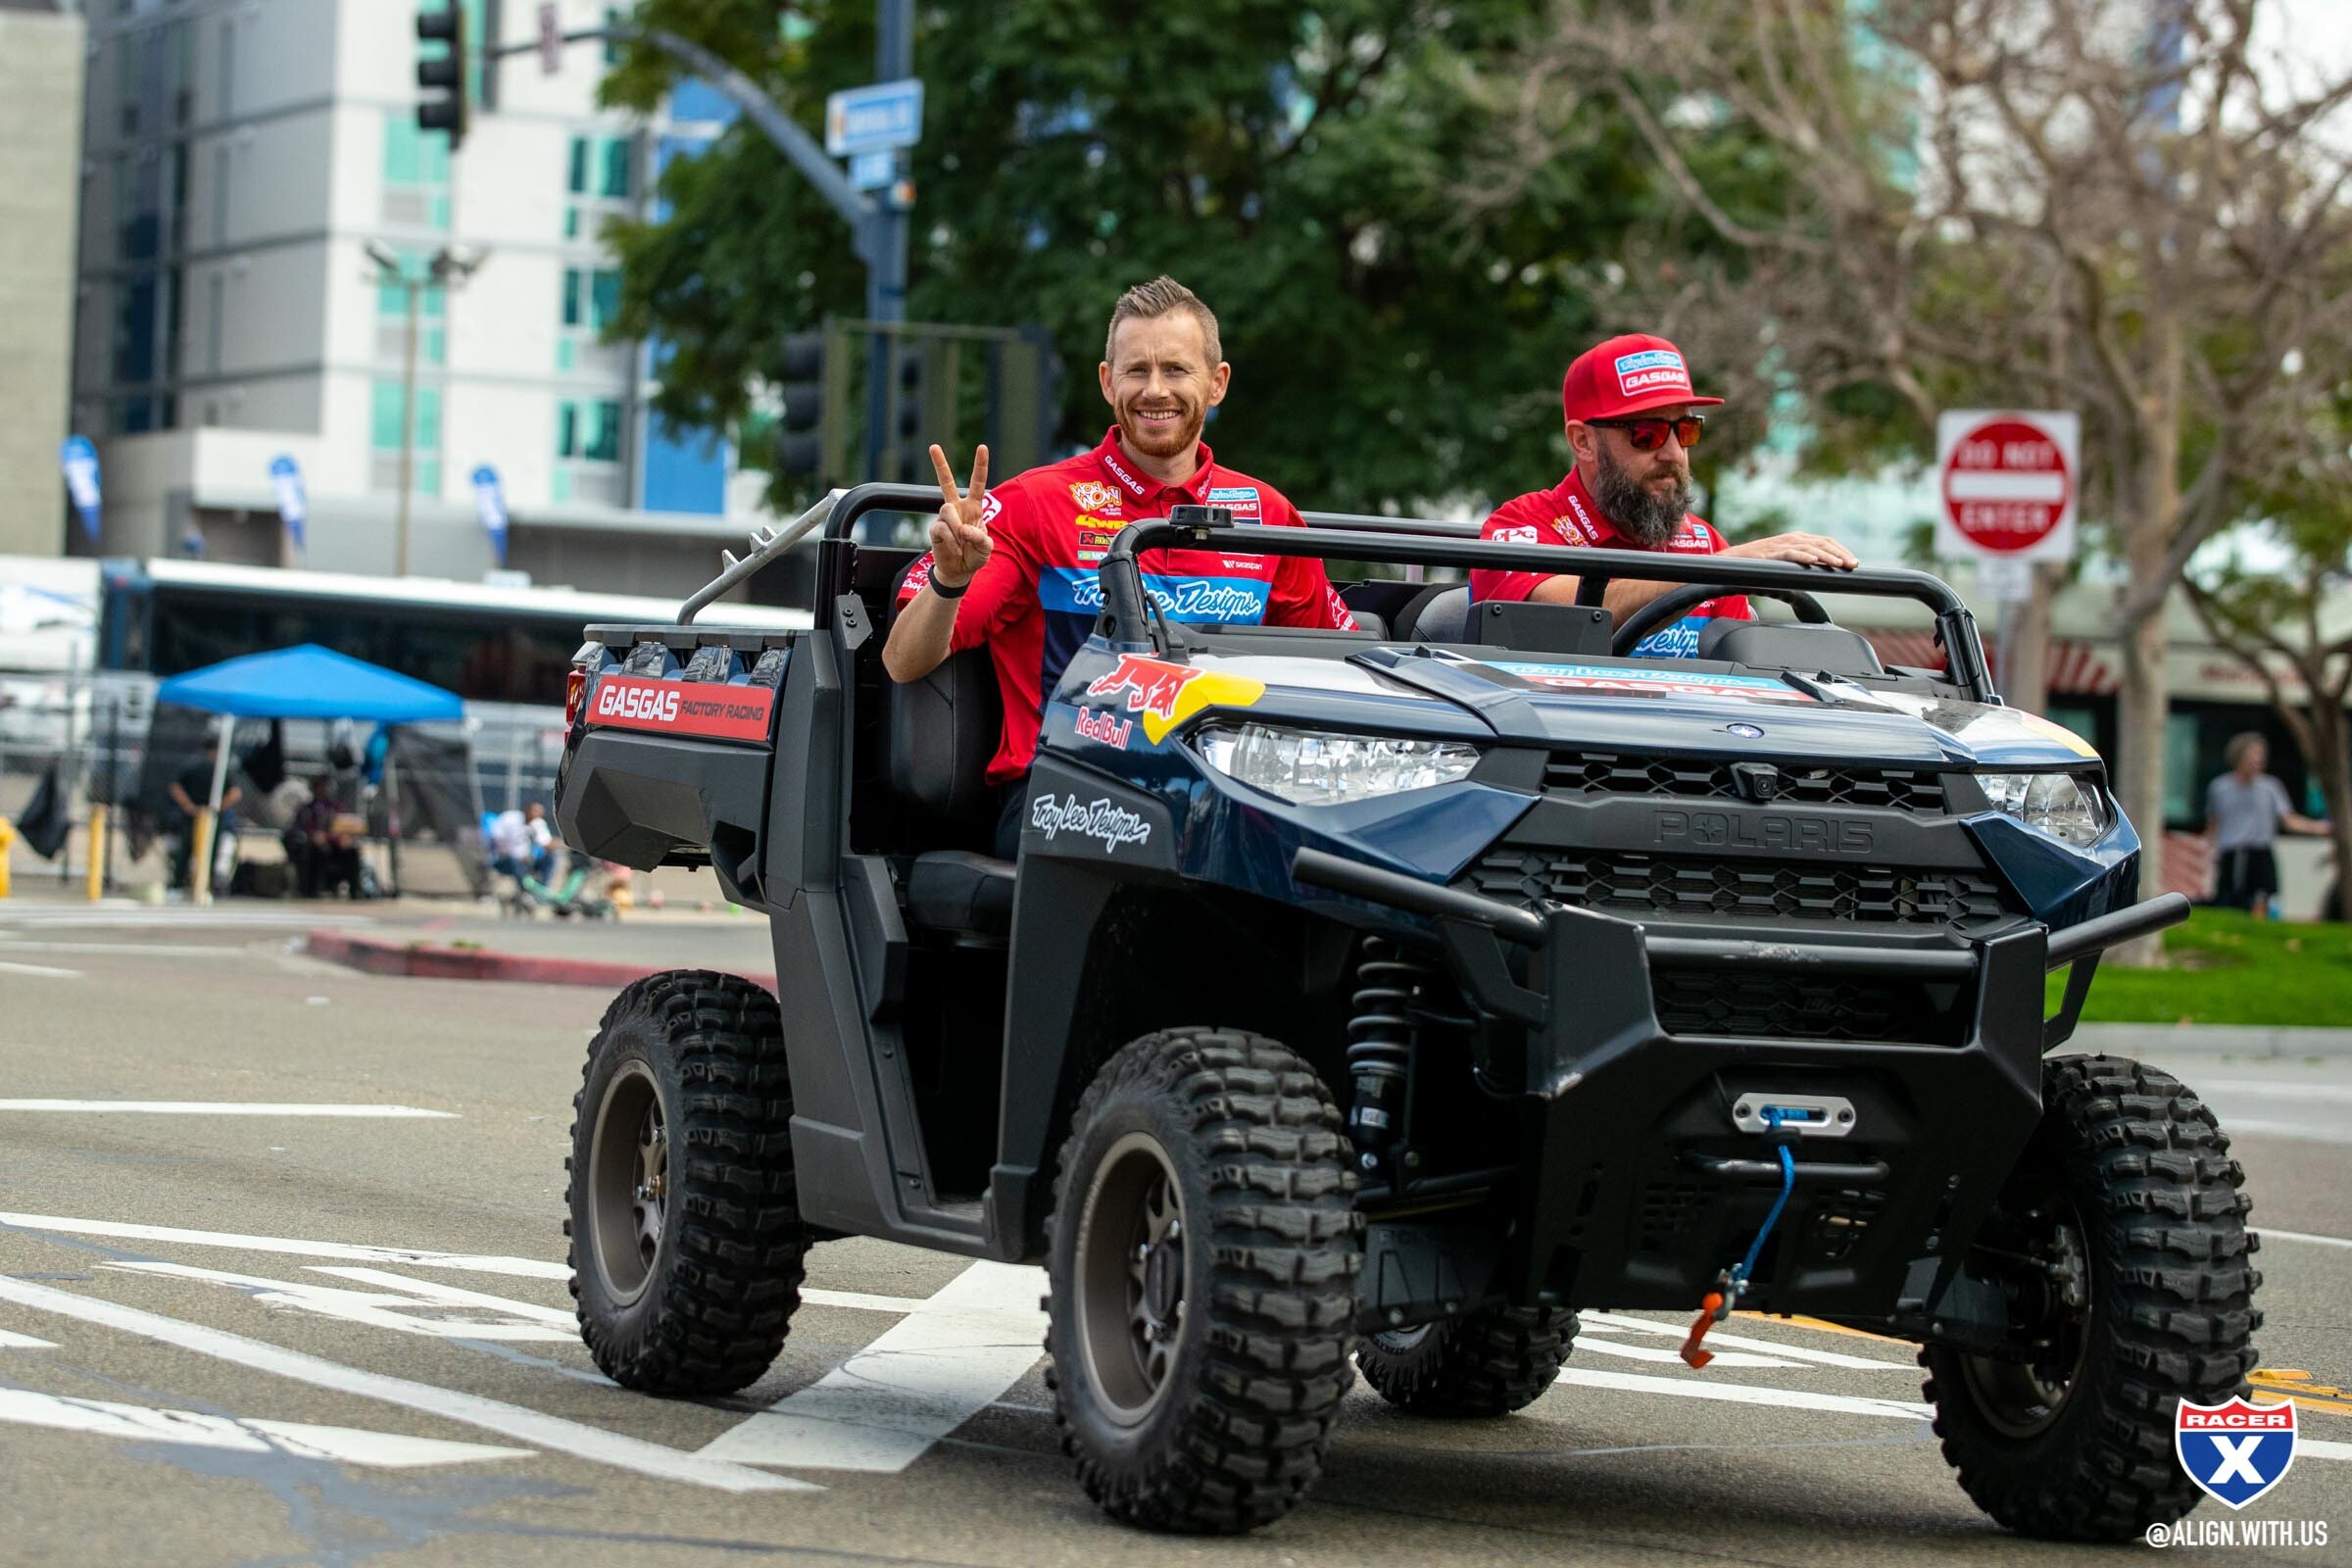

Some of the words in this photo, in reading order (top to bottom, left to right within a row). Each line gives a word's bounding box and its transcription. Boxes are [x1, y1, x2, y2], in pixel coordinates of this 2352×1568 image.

[1626, 371, 1686, 388] GASGAS
[1958, 440, 1998, 468] DO
[2002, 440, 2055, 469] NOT
[1104, 455, 1146, 495] GASGAS
[1568, 495, 1599, 540] GASGAS
[1961, 503, 2051, 533] ENTER
[1235, 562, 1262, 570] seaspan
[1071, 576, 1105, 608] Tro
[1176, 580, 1261, 621] Designs
[599, 685, 680, 722] GASGAS
[680, 701, 726, 717] FACTORY
[725, 704, 764, 721] RACING
[1544, 678, 1798, 700] GASGAS
[1033, 794, 1060, 840] Troy
[1059, 794, 1089, 831] Lee
[1087, 798, 1151, 854] Designs
[1654, 810, 1873, 854] POLARIS
